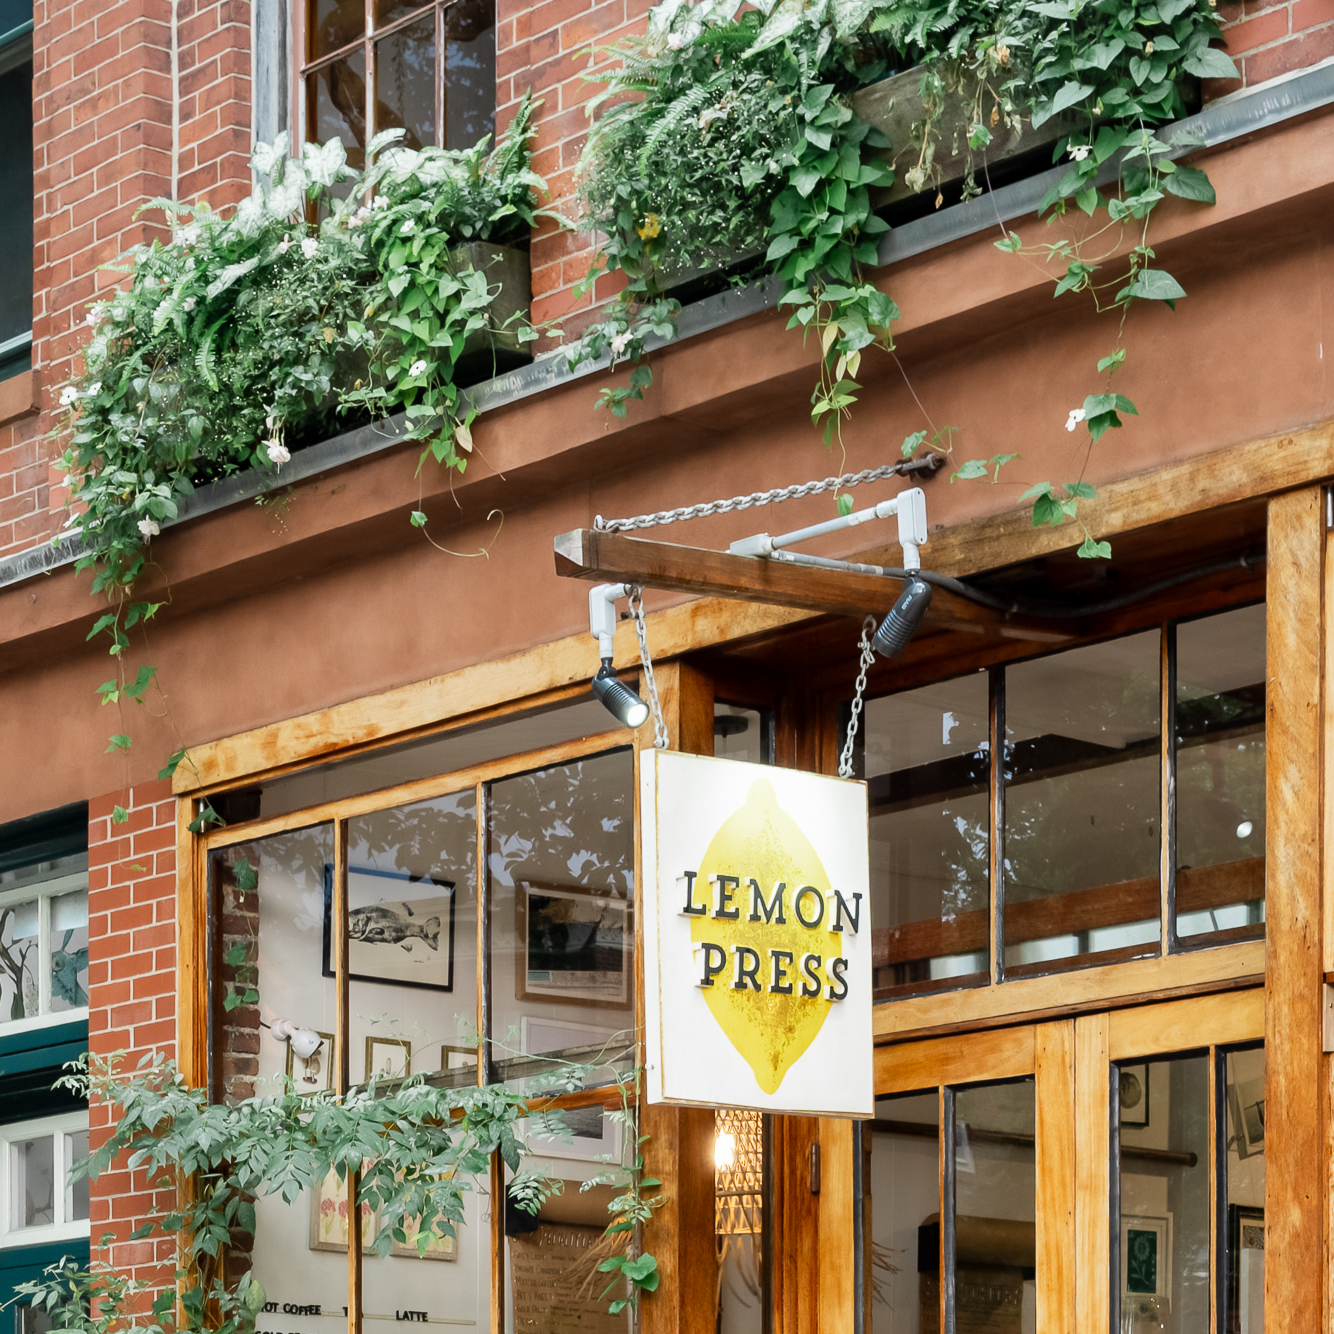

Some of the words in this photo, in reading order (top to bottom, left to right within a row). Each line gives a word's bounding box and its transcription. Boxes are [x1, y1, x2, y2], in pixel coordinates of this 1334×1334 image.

[676, 870, 863, 936] LEMON
[693, 942, 849, 1003] PRESS
[261, 1302, 279, 1313] OT
[283, 1303, 321, 1316] COFFEE
[395, 1310, 429, 1322] LATTE
